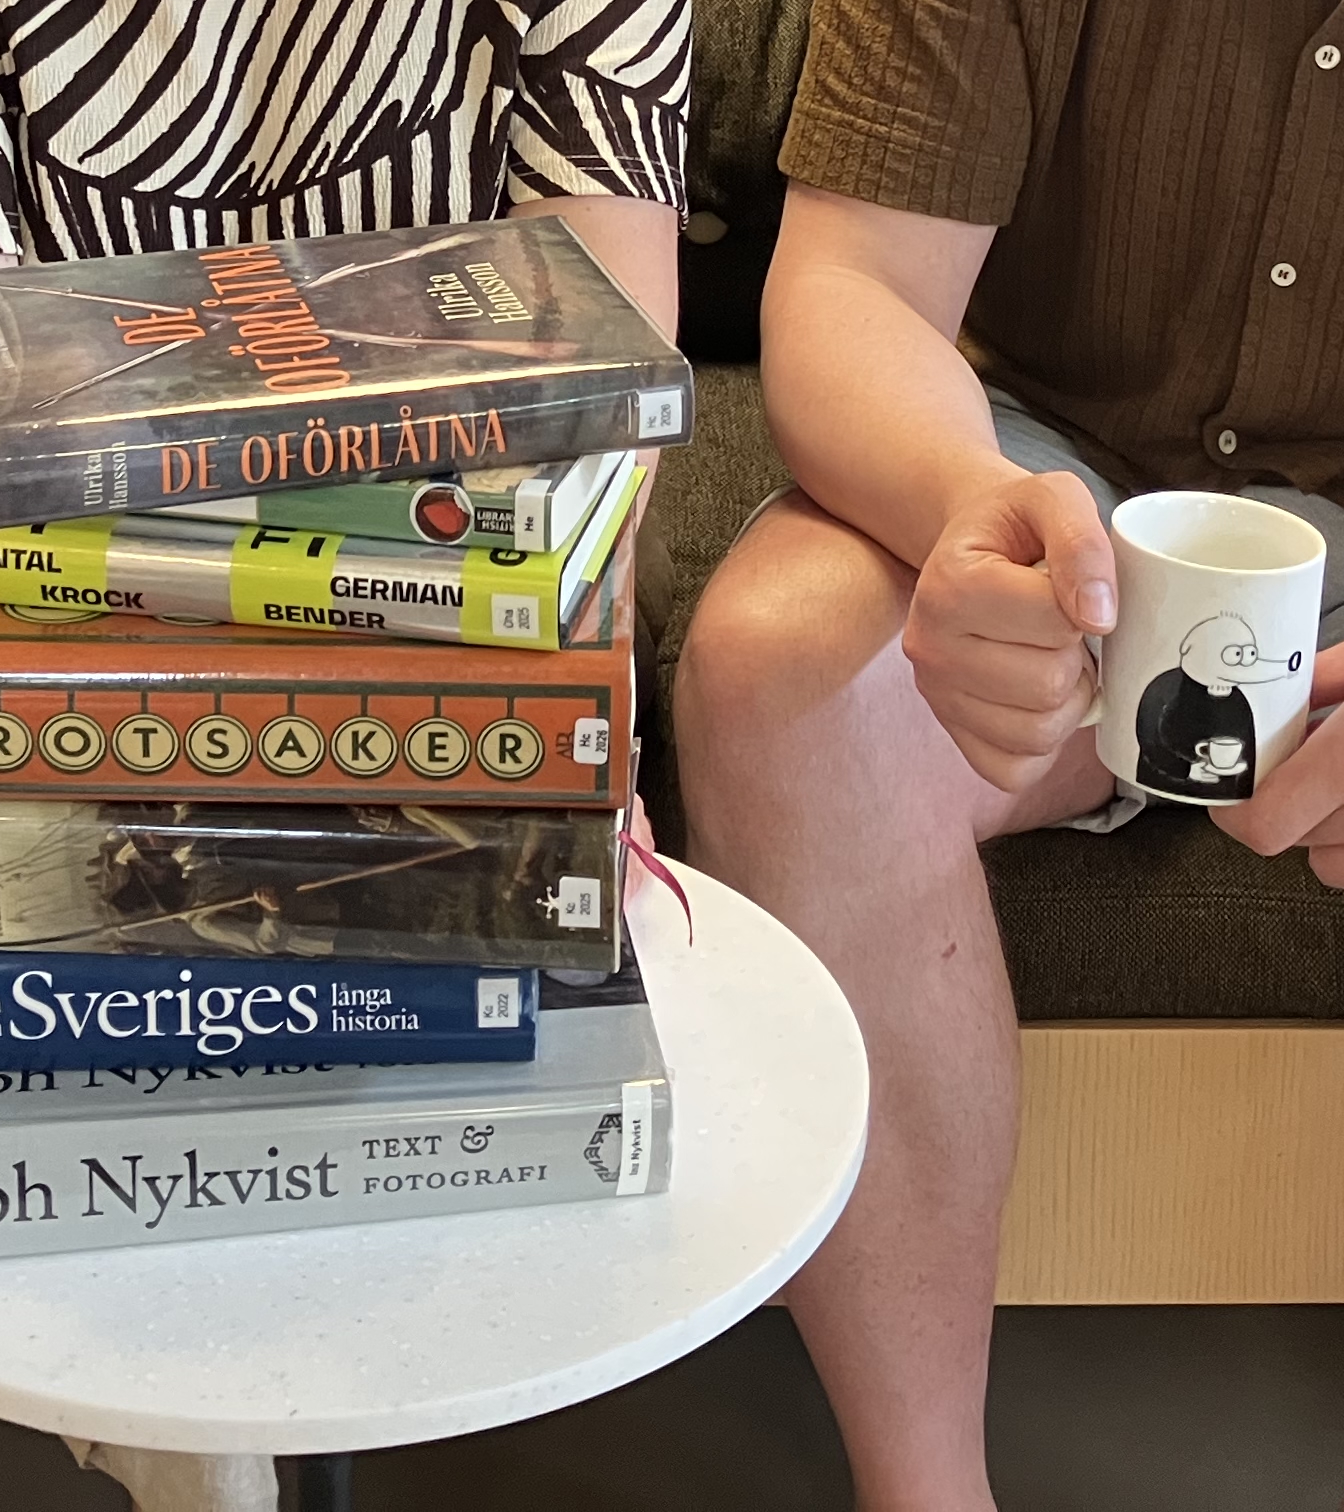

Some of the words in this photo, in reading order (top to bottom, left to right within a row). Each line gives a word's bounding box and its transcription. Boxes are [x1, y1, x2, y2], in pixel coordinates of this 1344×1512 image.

[426, 272, 484, 321] Ulrika
[464, 261, 534, 324] Hansson
[114, 306, 206, 346] DE
[198, 245, 351, 393] OFÖRLÅTNA
[161, 441, 222, 495] DE
[240, 404, 507, 485] OFÖRLÅTNA
[83, 452, 104, 507] Ulrika
[108, 440, 129, 510] Hansson
[476, 510, 516, 523] LIBRAR
[40, 584, 146, 610] KROCK
[329, 575, 465, 608] GERMAN
[263, 603, 386, 630] BENDER
[579, 733, 591, 748] Hc
[9, 968, 320, 1057] Sveriges
[331, 982, 393, 1013] långa
[497, 993, 509, 1018] 2022
[331, 1009, 420, 1033] historia
[361, 1135, 443, 1160] TEXT
[460, 1124, 495, 1154] &
[630, 1119, 643, 1161] Nykvist
[80, 1146, 341, 1230] Nykvist
[362, 1164, 548, 1195] FOTOGRAFI
